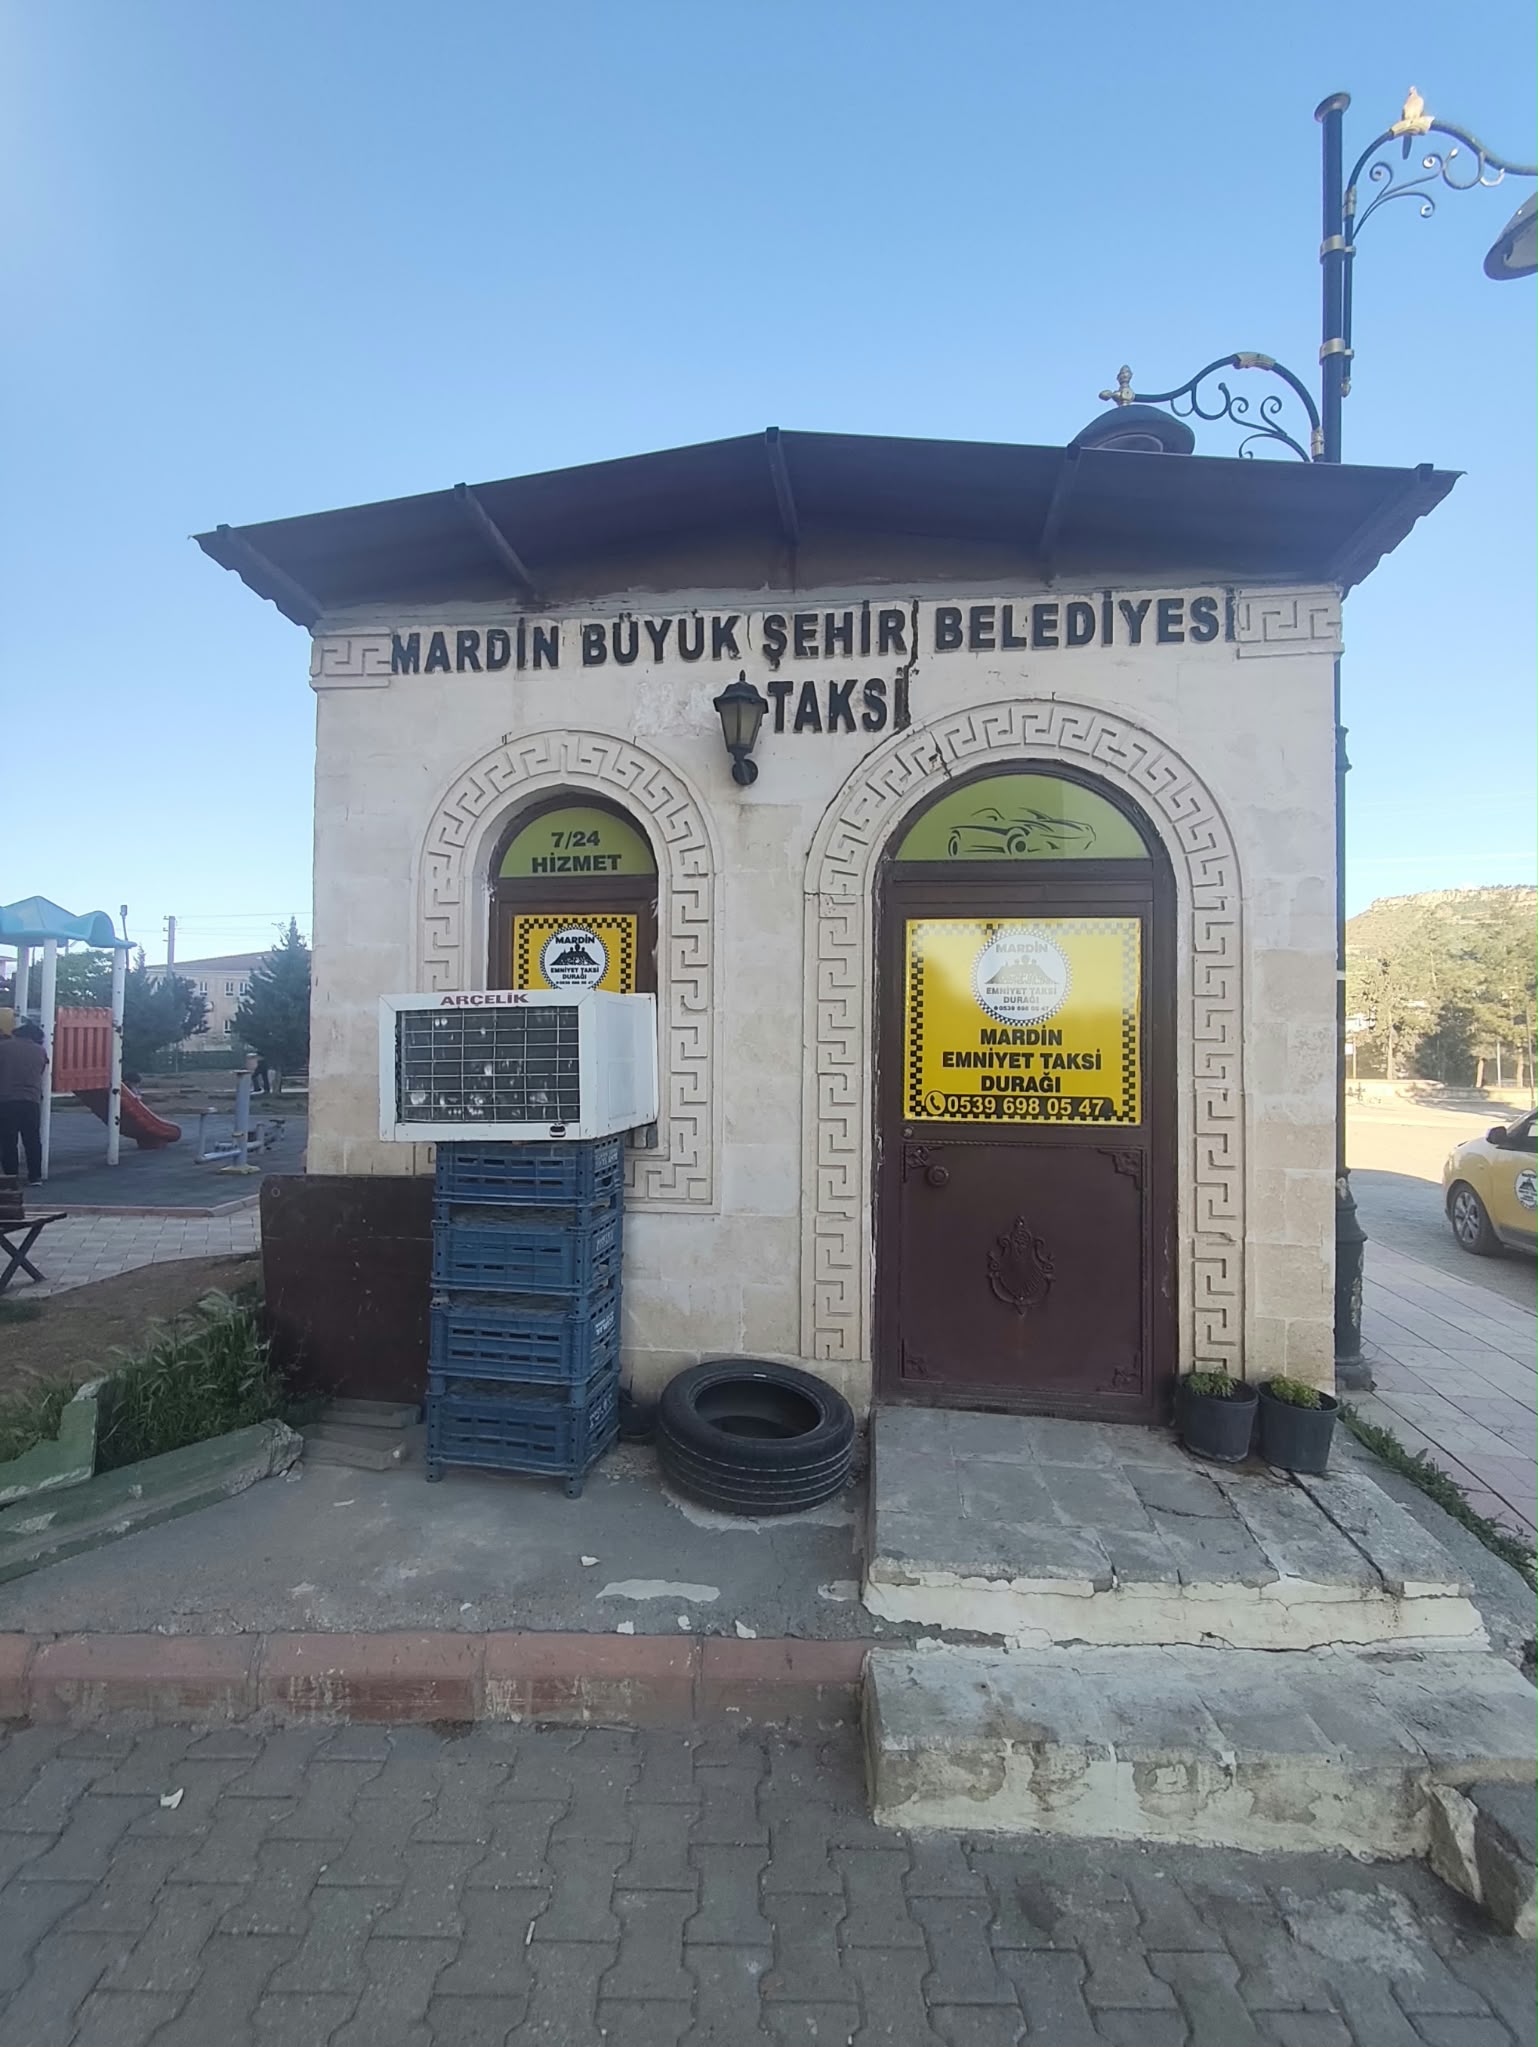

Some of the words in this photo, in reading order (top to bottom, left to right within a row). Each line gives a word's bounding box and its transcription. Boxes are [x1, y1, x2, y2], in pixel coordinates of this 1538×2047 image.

[391, 617, 560, 675] MARDİN
[582, 608, 743, 667] BÜYÜK
[762, 600, 908, 671] ŞEHİR
[933, 587, 1236, 652] BELEDİYESİ
[767, 667, 910, 734] TAKSİ
[551, 830, 600, 849] 7/24
[531, 852, 622, 873] HİZMET
[555, 934, 595, 944] MARDİN
[995, 941, 1048, 953] MARDİN
[440, 993, 528, 1006] ARÇELİK
[980, 1025, 1062, 1046] MARDİN
[942, 1048, 1034, 1069] EMNİYET
[1040, 1049, 1102, 1070] TAKSİ
[981, 1072, 1061, 1093] DURAĞI
[947, 1096, 996, 1113] 0539
[1003, 1097, 1040, 1114] 698
[1047, 1098, 1072, 1115] 05
[1078, 1099, 1103, 1115] 47
